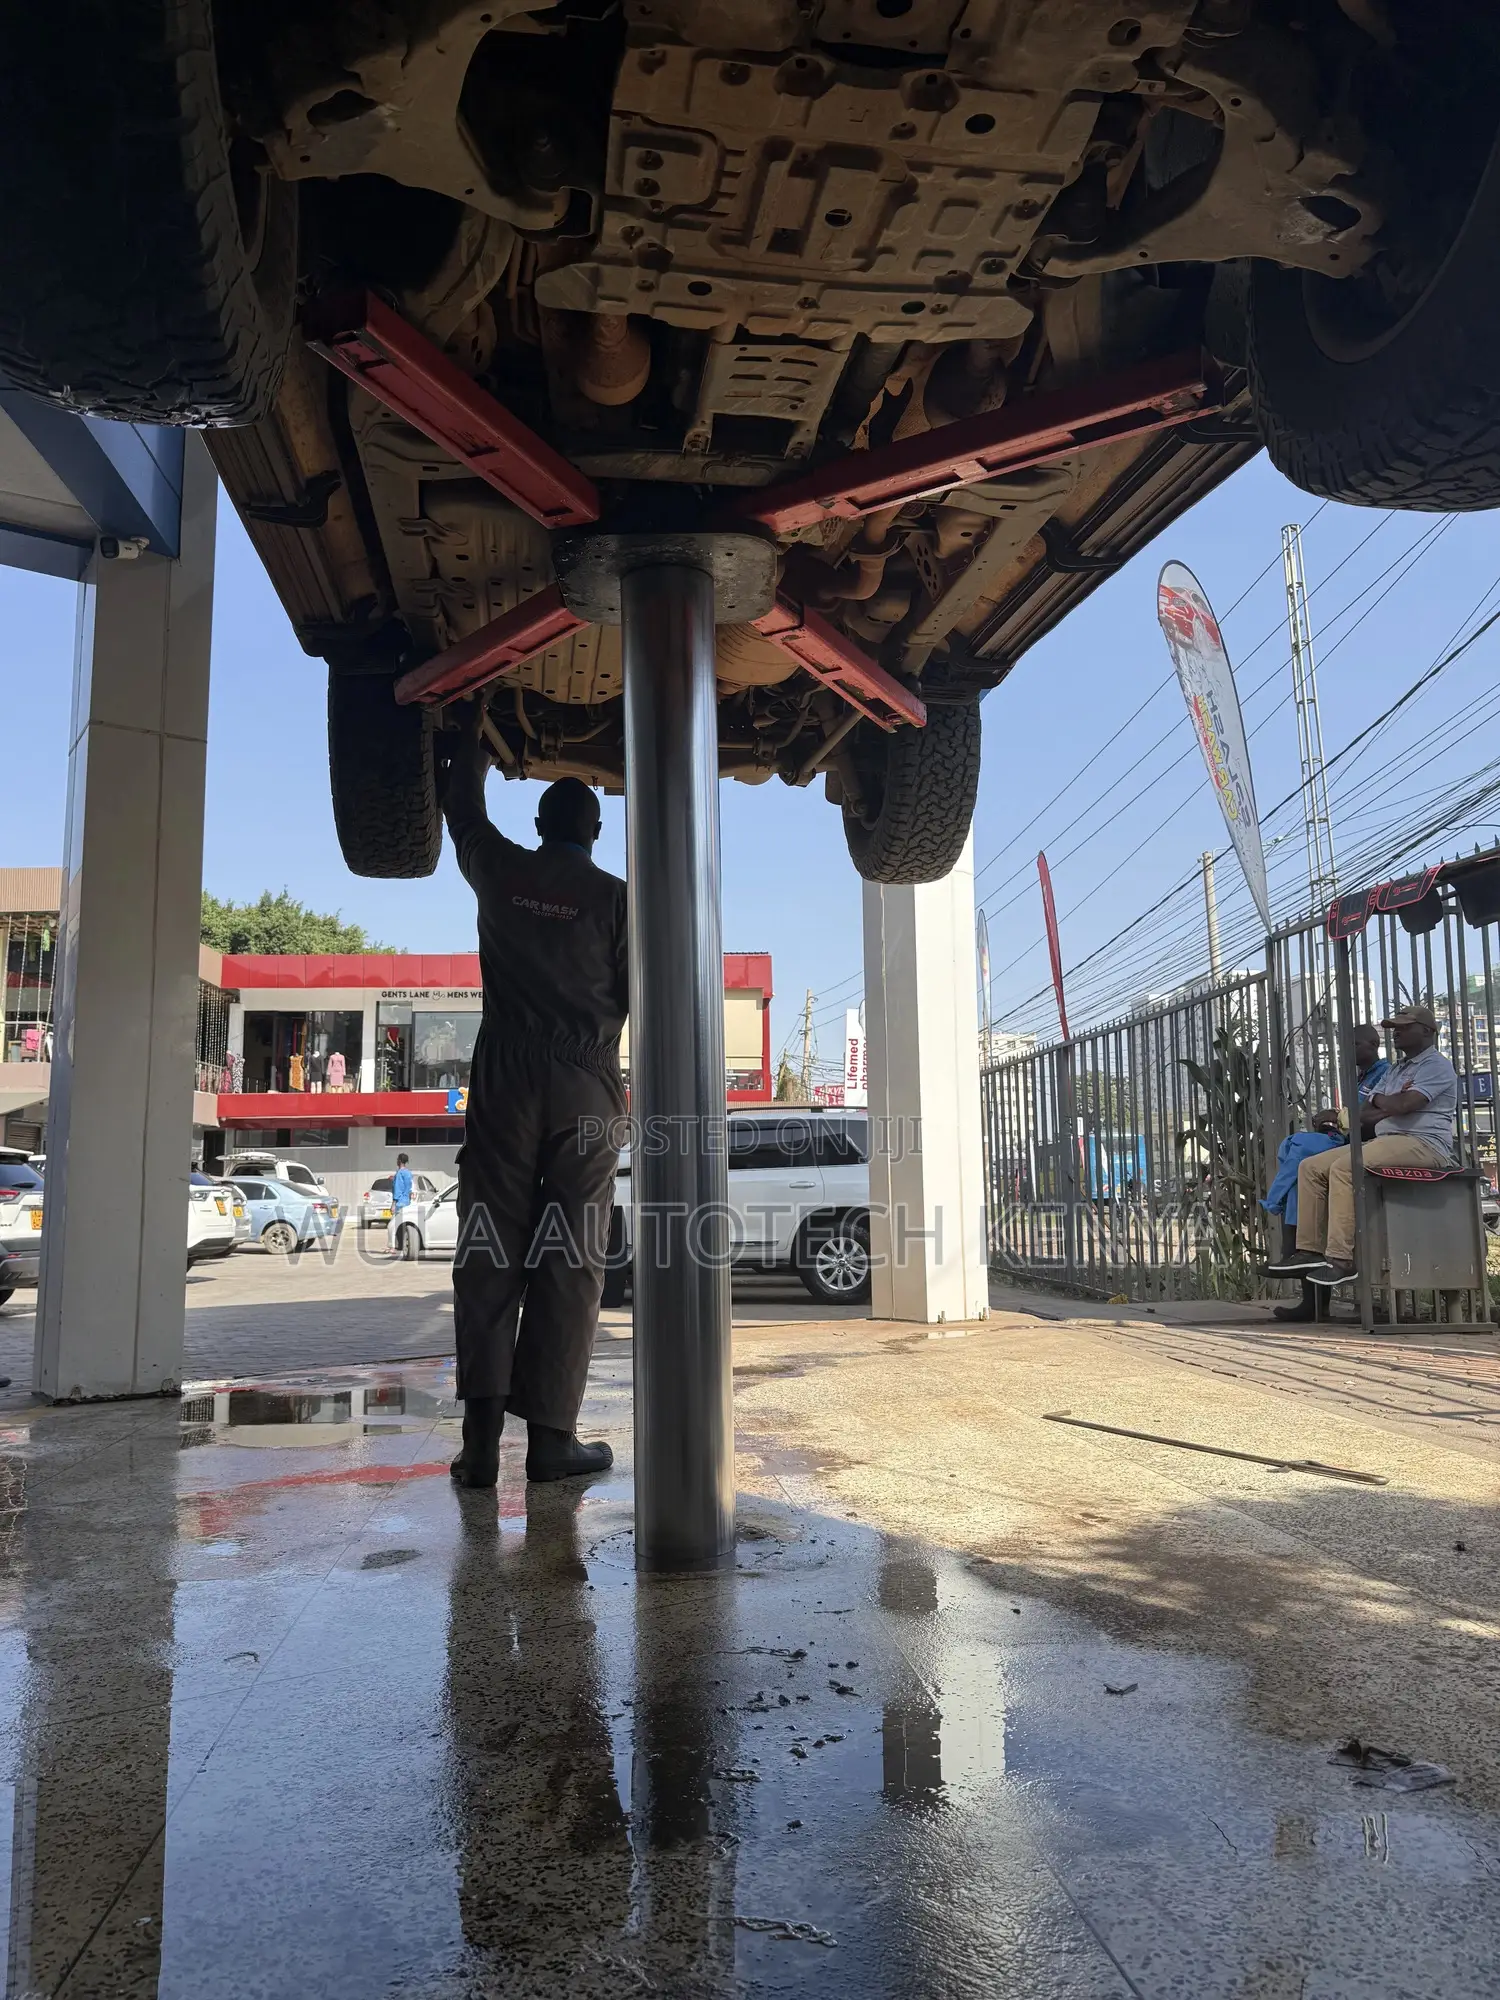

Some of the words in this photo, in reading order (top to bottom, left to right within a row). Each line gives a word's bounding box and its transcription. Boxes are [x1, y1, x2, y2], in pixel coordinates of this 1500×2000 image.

[512, 896, 540, 910] CAR
[541, 903, 578, 916] WASH
[847, 1038, 859, 1090] Lifemed
